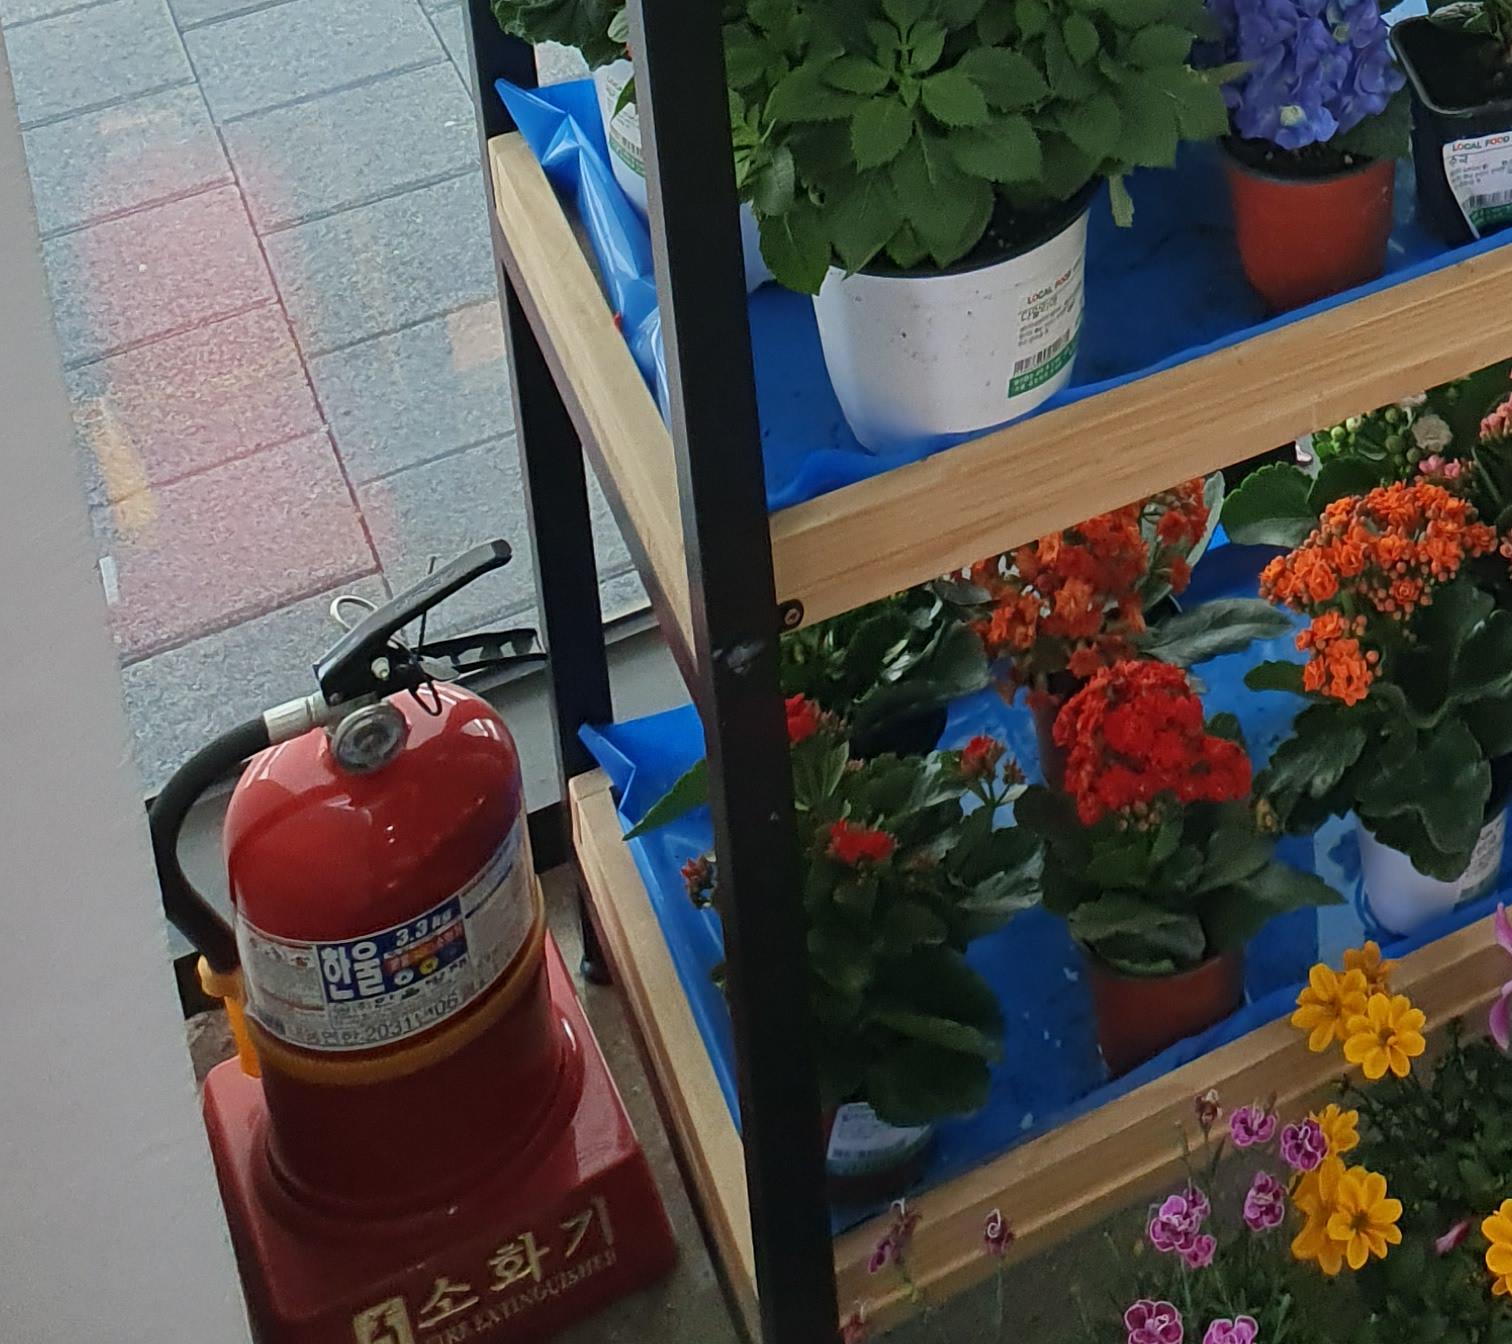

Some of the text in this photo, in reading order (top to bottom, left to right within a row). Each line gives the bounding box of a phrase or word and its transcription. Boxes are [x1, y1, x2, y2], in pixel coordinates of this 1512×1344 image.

[1452, 135, 1510, 152] LOCAL FOOD
[320, 941, 385, 1000] 한울
[417, 1195, 614, 1329] 소화기
